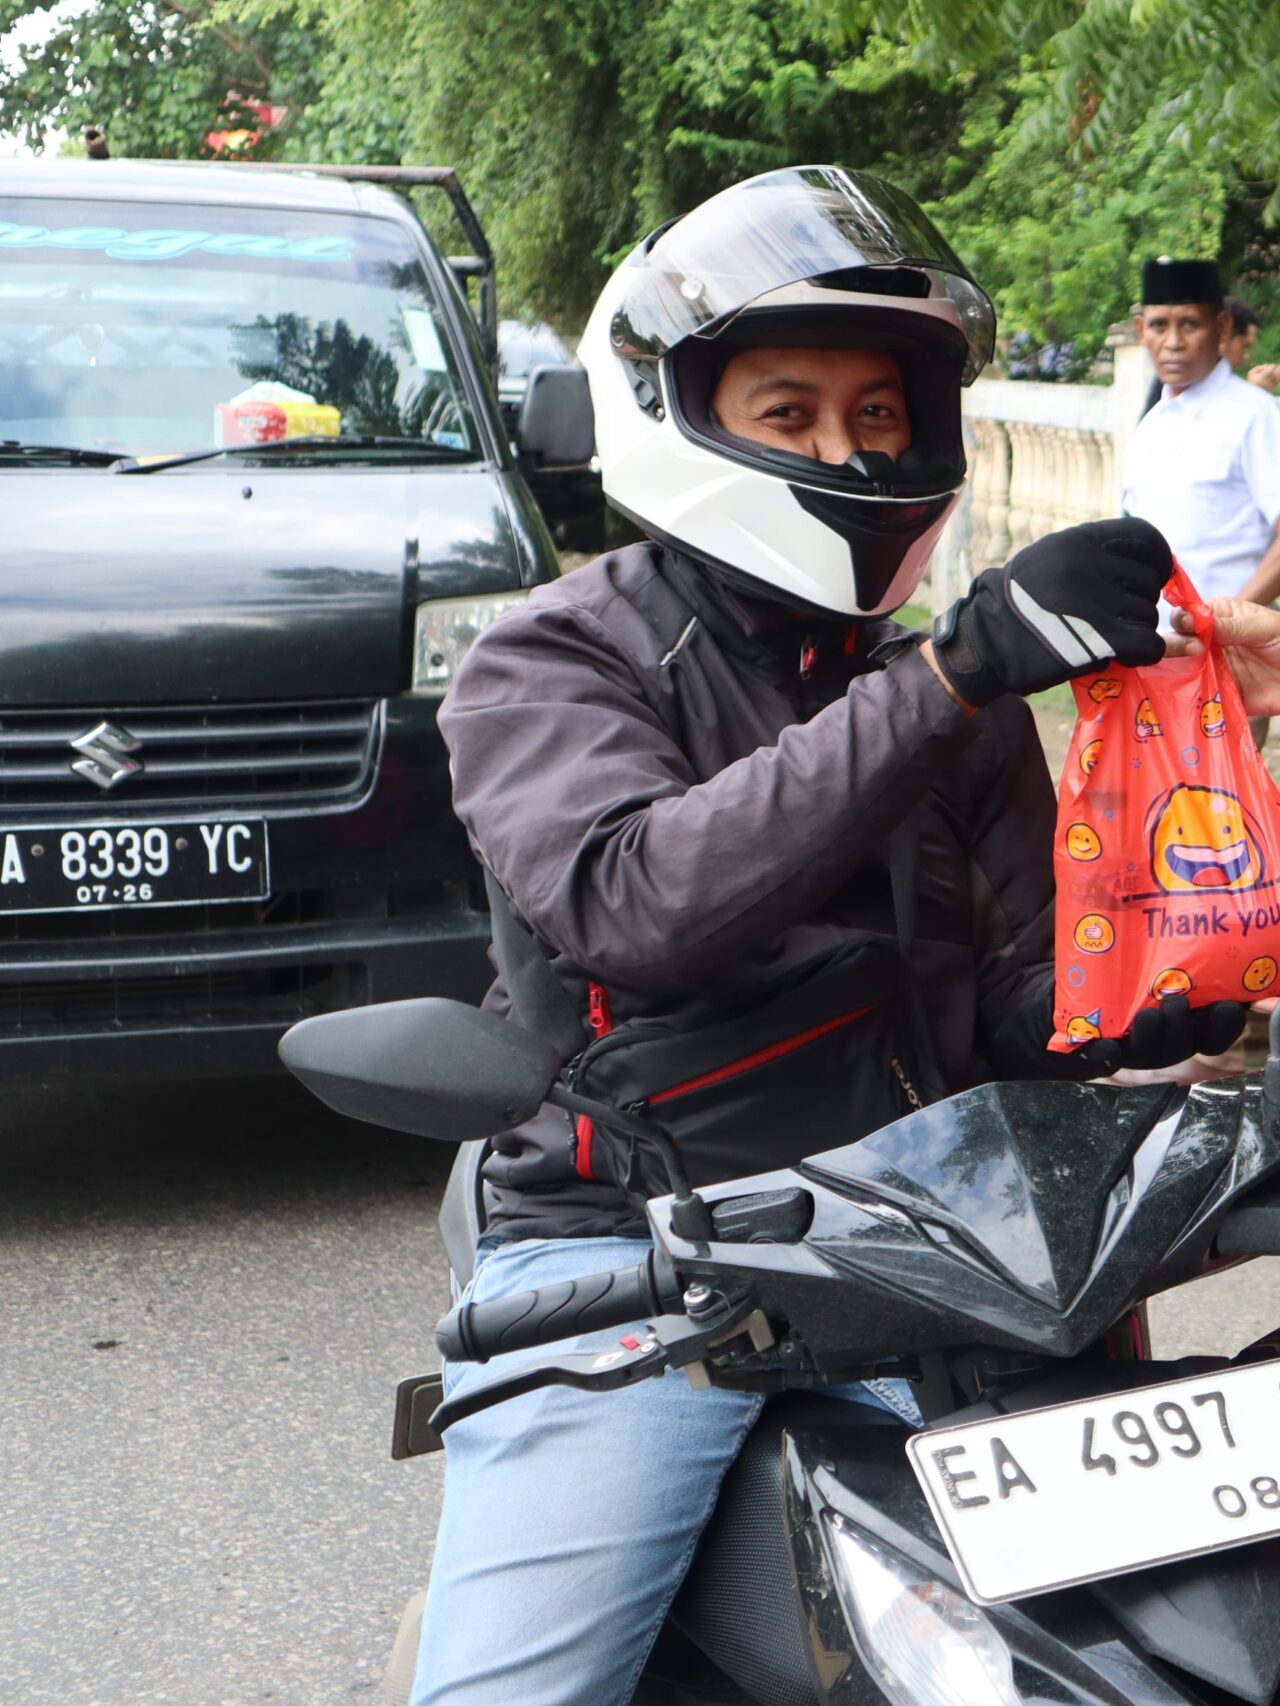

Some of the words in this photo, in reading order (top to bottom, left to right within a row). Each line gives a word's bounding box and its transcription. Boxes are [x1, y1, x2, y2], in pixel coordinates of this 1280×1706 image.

[60, 828, 169, 880] 8339
[199, 824, 252, 874] YC
[1142, 907, 1229, 938] Thank
[931, 1437, 1037, 1510] EA
[1081, 1391, 1236, 1476] 4997
